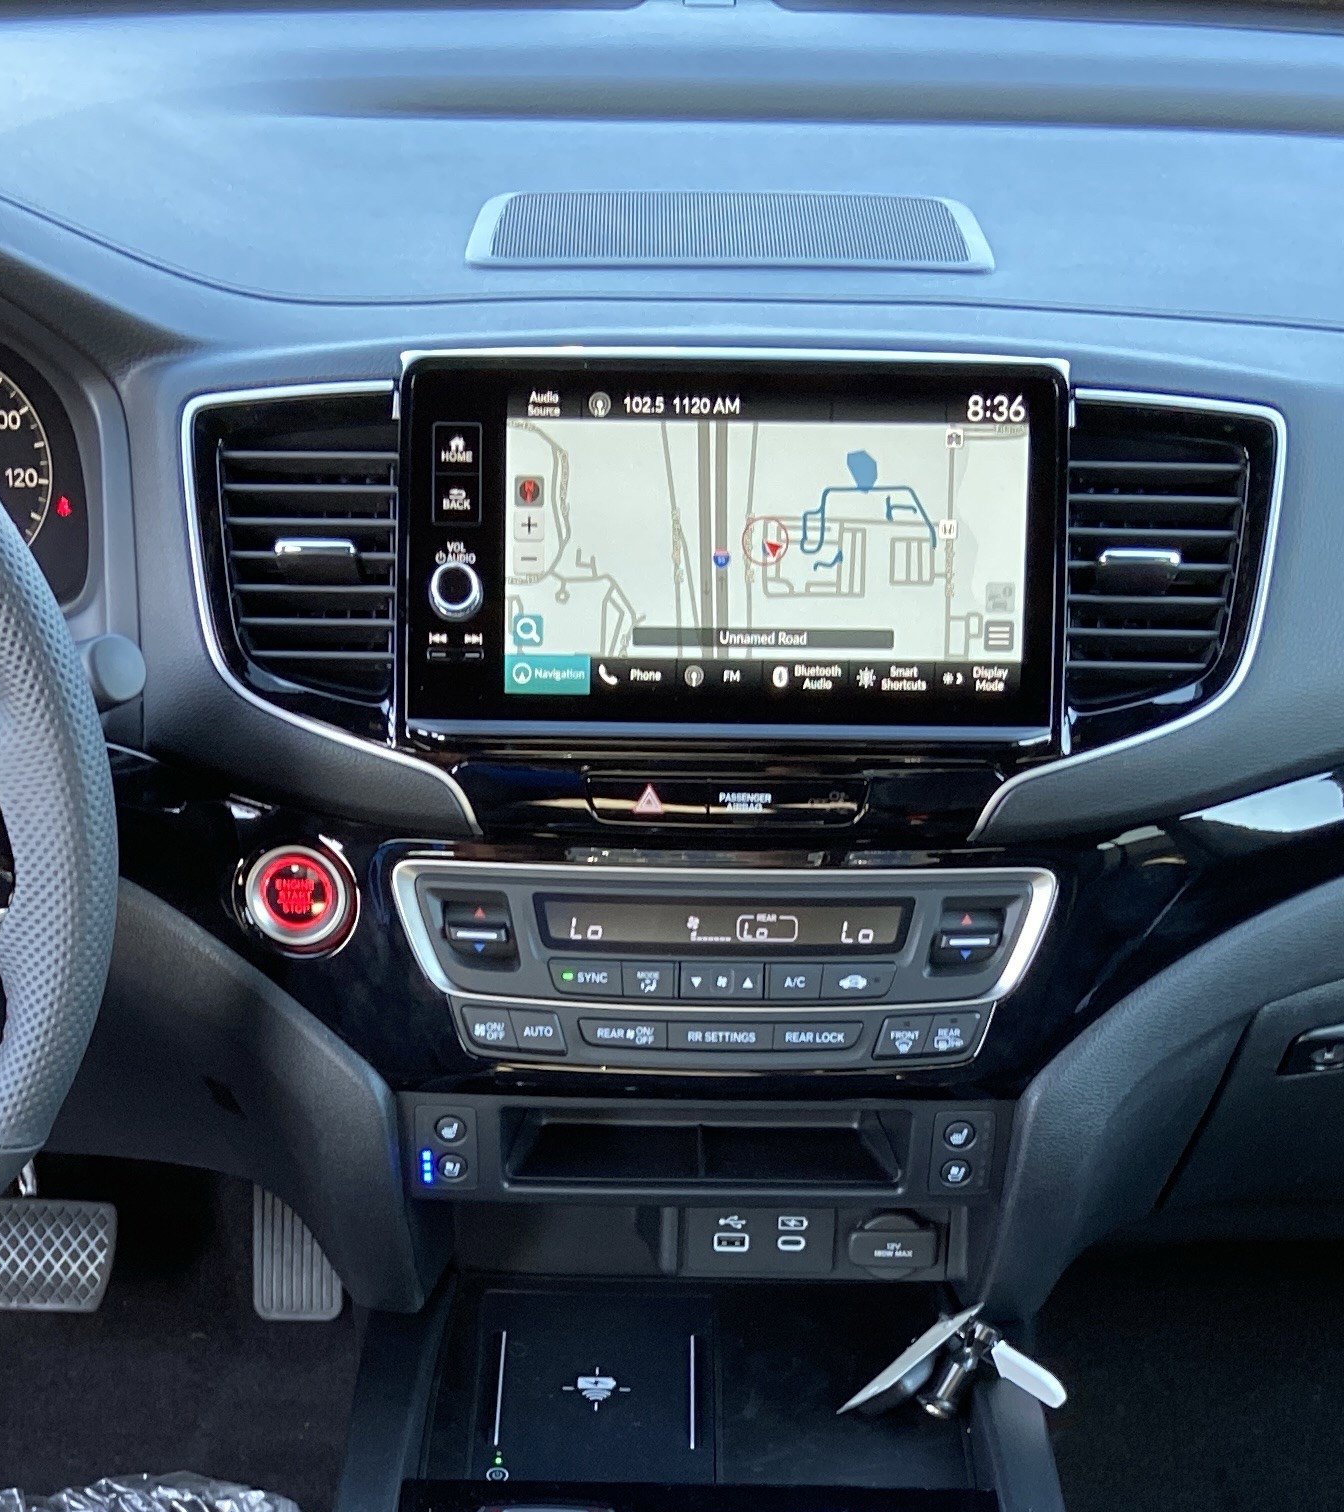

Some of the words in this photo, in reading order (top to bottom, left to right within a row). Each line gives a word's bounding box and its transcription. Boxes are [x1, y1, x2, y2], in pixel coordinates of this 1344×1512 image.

[529, 391, 559, 404] Audio
[527, 405, 561, 417] Source
[624, 397, 665, 414] 102.5
[673, 397, 711, 414] 1120
[713, 397, 741, 414] AM
[967, 395, 1026, 422] 8:36
[441, 450, 473, 463] HOME
[5, 468, 38, 488] 120
[442, 499, 471, 511] BACK
[446, 541, 466, 553] VOL
[446, 553, 476, 565] AUDIO
[719, 630, 775, 645] Unnamed
[779, 631, 808, 645] Road
[534, 668, 585, 681] Navigation
[630, 668, 661, 682] Phone
[723, 670, 740, 682] FM
[794, 664, 842, 677] Bluetooth
[890, 664, 919, 678] Smart
[972, 665, 1009, 680] Display
[802, 677, 833, 690] Audio
[881, 678, 927, 691] Shortcuts
[975, 680, 1005, 692] Mode
[719, 792, 772, 803] PASSENGER
[726, 803, 763, 813] AIRBAG
[275, 878, 314, 890] ENGINE
[278, 889, 313, 901] START
[282, 902, 310, 914] STOP
[756, 913, 777, 923] REAR
[569, 917, 603, 941] Lo
[841, 921, 875, 944] Lo
[577, 971, 608, 985] SYNC
[637, 970, 660, 980] MODE
[784, 976, 806, 988] A/C
[486, 1031, 505, 1041] OFF
[523, 1026, 553, 1037] AUTO
[596, 1027, 624, 1039] REAR
[687, 1031, 702, 1042] RR
[705, 1031, 756, 1043] SETTINGS
[785, 1031, 814, 1043] REAR
[815, 1032, 845, 1043] LOCK
[890, 1030, 919, 1041] FRONT
[937, 1028, 961, 1038] REAR
[635, 1035, 654, 1045] OFF
